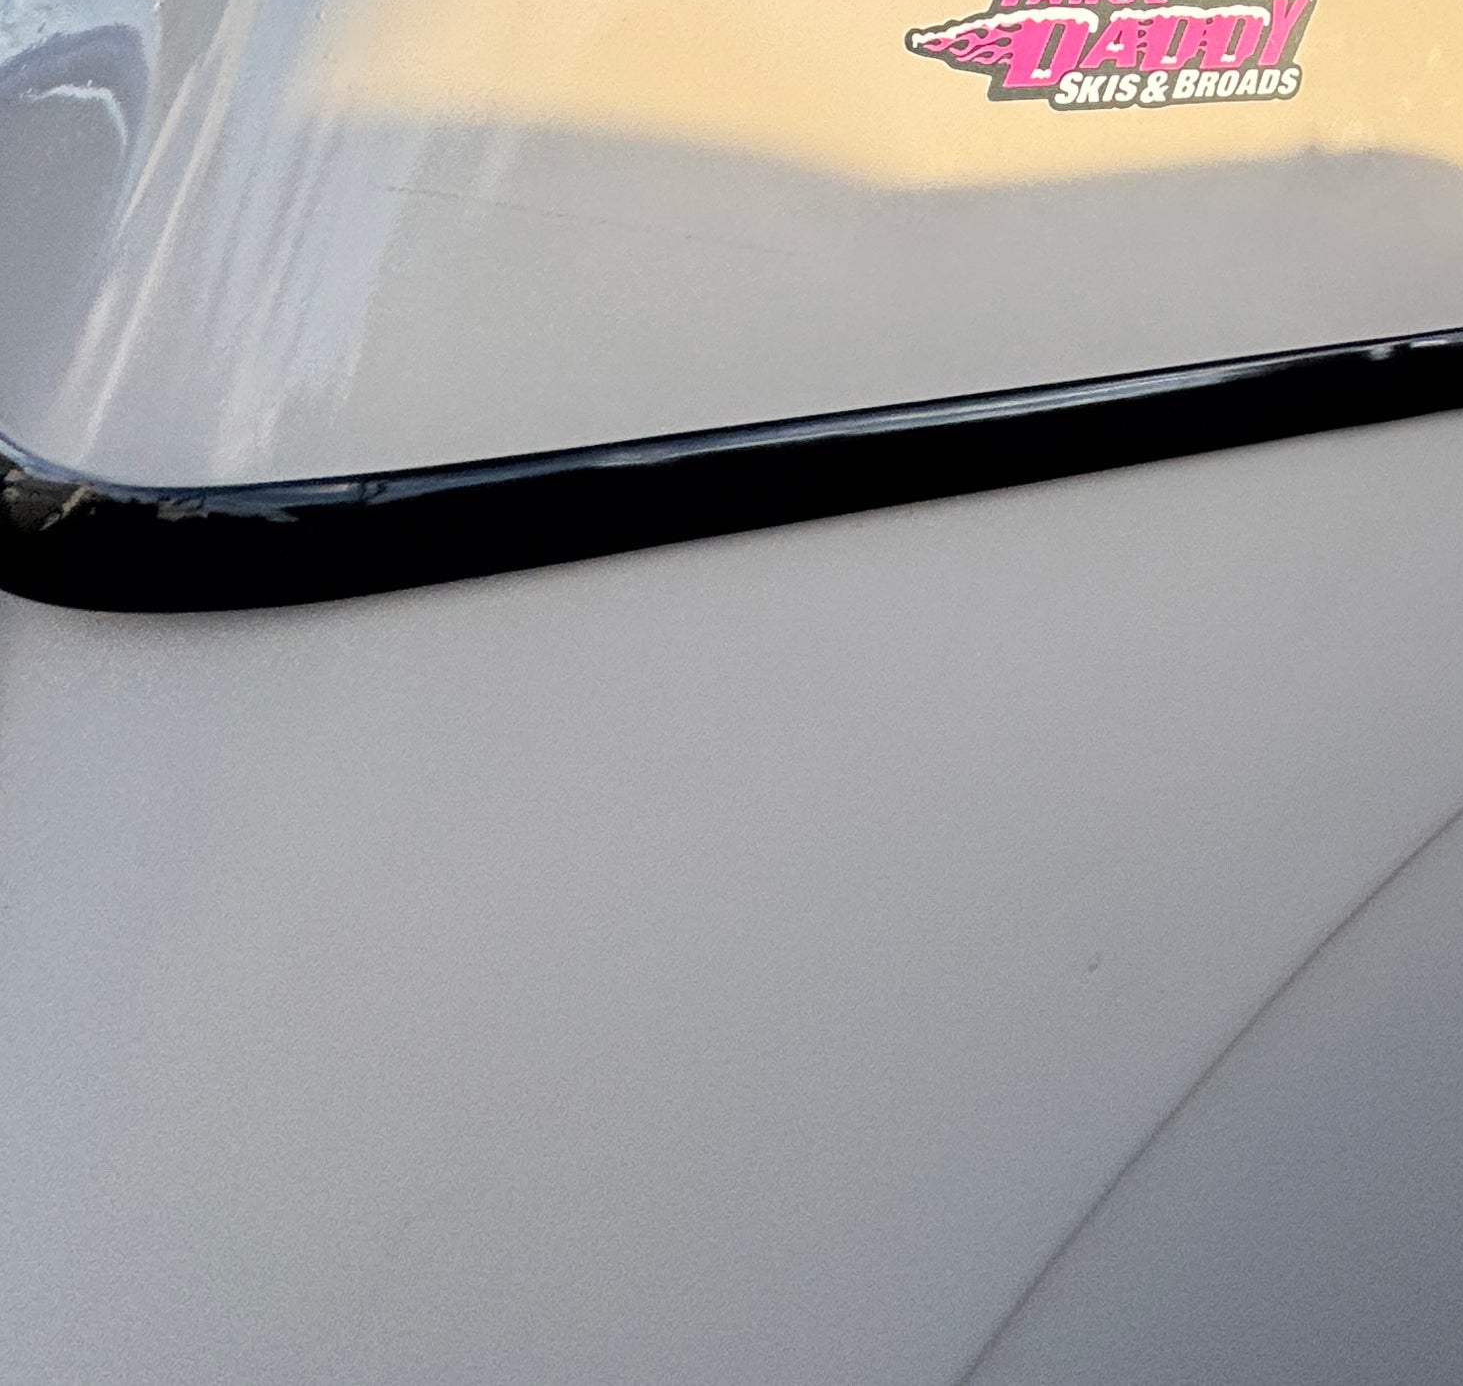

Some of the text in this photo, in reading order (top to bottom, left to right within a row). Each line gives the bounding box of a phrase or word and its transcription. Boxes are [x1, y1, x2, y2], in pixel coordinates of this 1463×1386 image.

[1054, 67, 1300, 104] SKIS & BROADS
